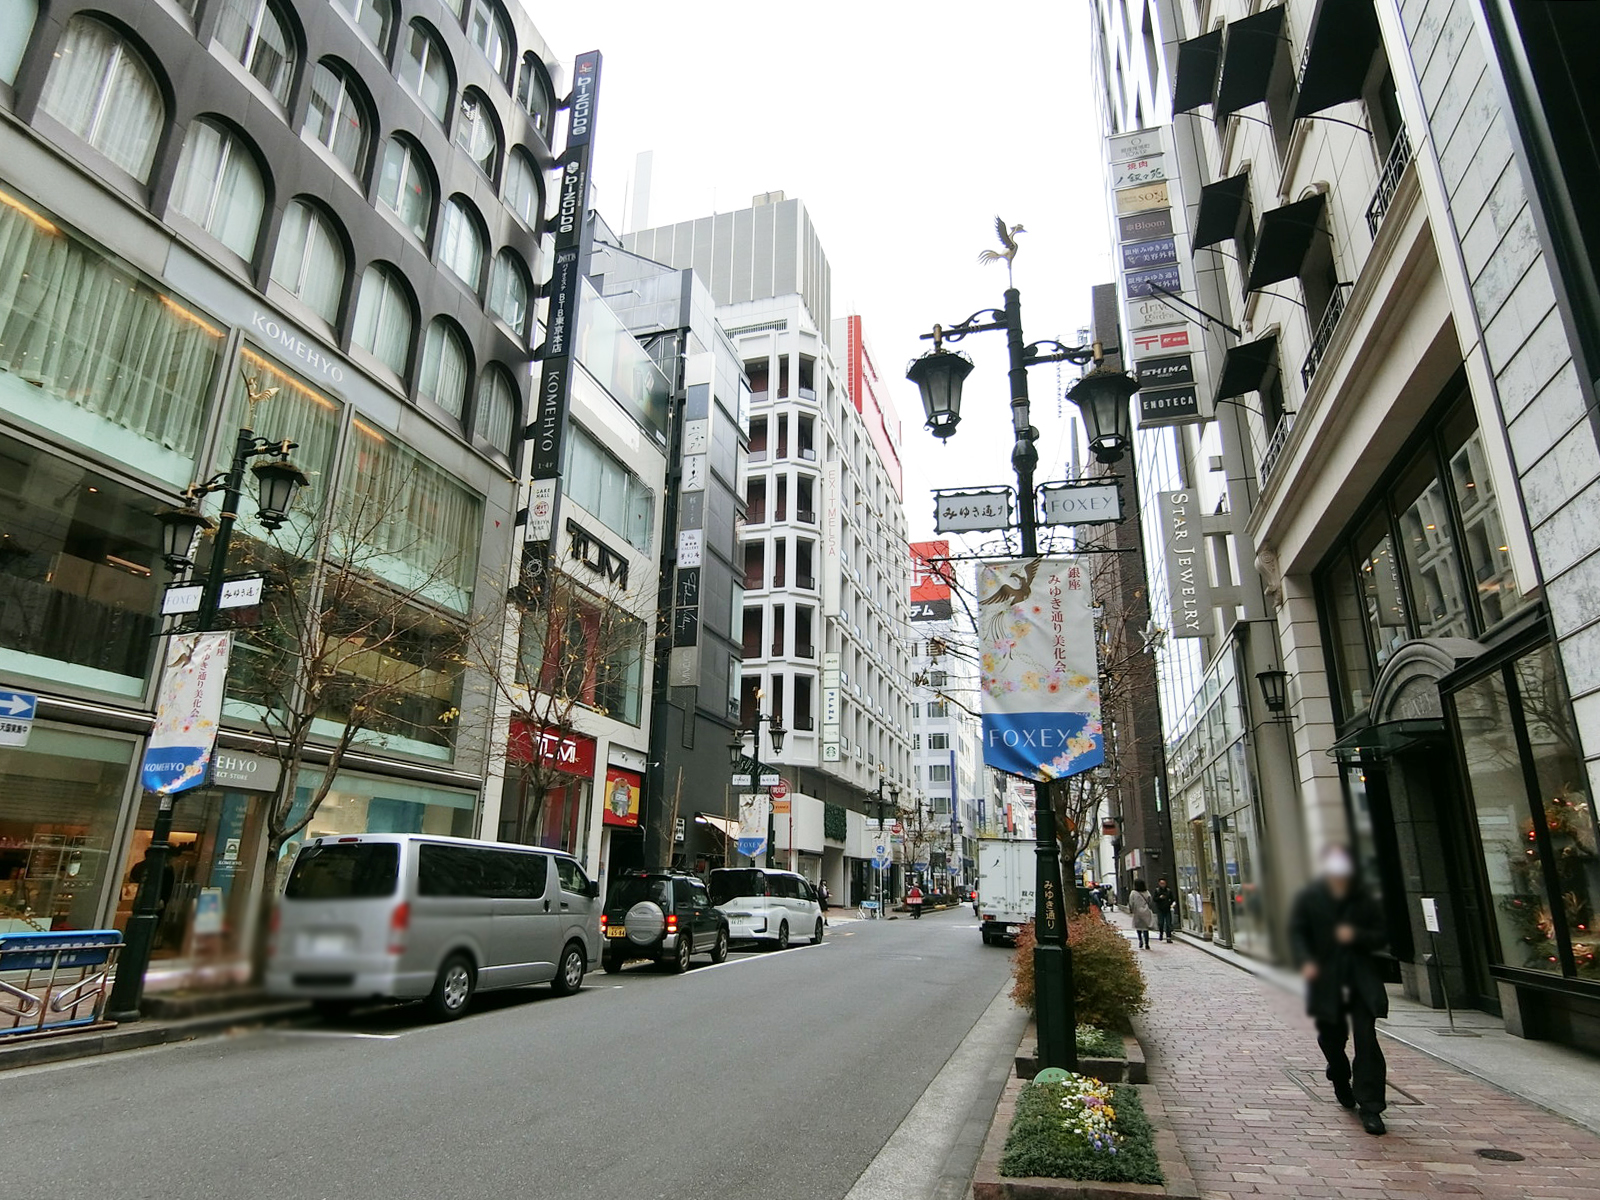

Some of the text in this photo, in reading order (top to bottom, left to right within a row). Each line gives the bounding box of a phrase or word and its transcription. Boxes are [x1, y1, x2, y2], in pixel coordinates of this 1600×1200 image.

[1127, 161, 1148, 170] 焼肉
[251, 310, 344, 384] KOMEHYO
[1141, 365, 1188, 376] SHIMA
[541, 370, 560, 452] KOMEHYO
[1143, 396, 1194, 410] ENOTECA
[942, 504, 1003, 519] みゆき通り
[1051, 496, 1113, 513] FOXEY
[1171, 493, 1200, 631] STAR JEWELRY
[1067, 567, 1082, 591] 銀座
[166, 594, 198, 606] FOXEY
[1048, 574, 1067, 673] みゆき通り美化会
[216, 638, 228, 657] 銀座
[988, 728, 1071, 749] FOXEY
[144, 762, 185, 772] KOMEHYO
[216, 755, 258, 773] EHYO
[1043, 880, 1056, 930] みゆき通り
